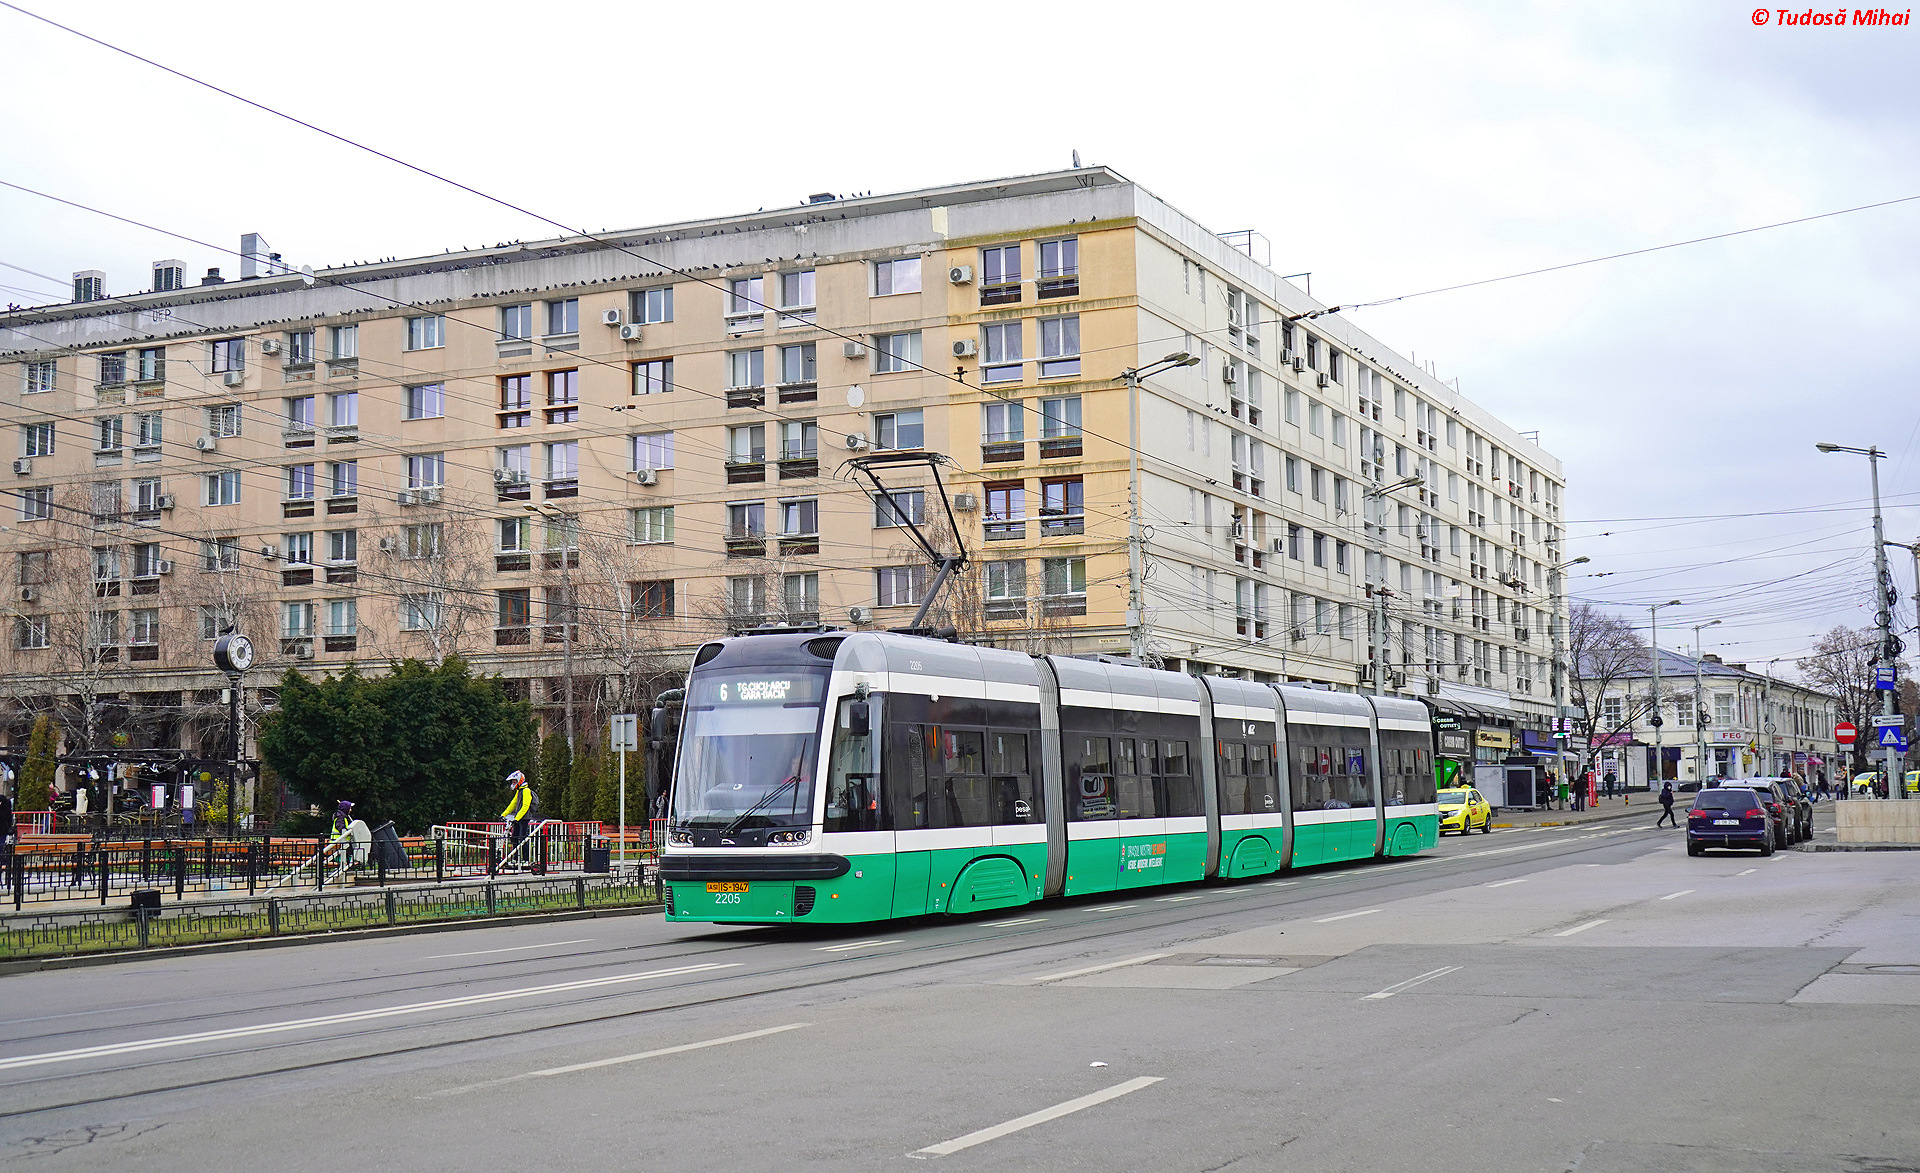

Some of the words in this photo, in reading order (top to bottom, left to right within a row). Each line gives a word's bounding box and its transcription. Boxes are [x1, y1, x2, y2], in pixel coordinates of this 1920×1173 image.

[720, 683, 728, 701] 6
[740, 689, 786, 700] GARA-DACIA
[720, 882, 749, 892] IS-1947
[715, 893, 741, 904] 2205
